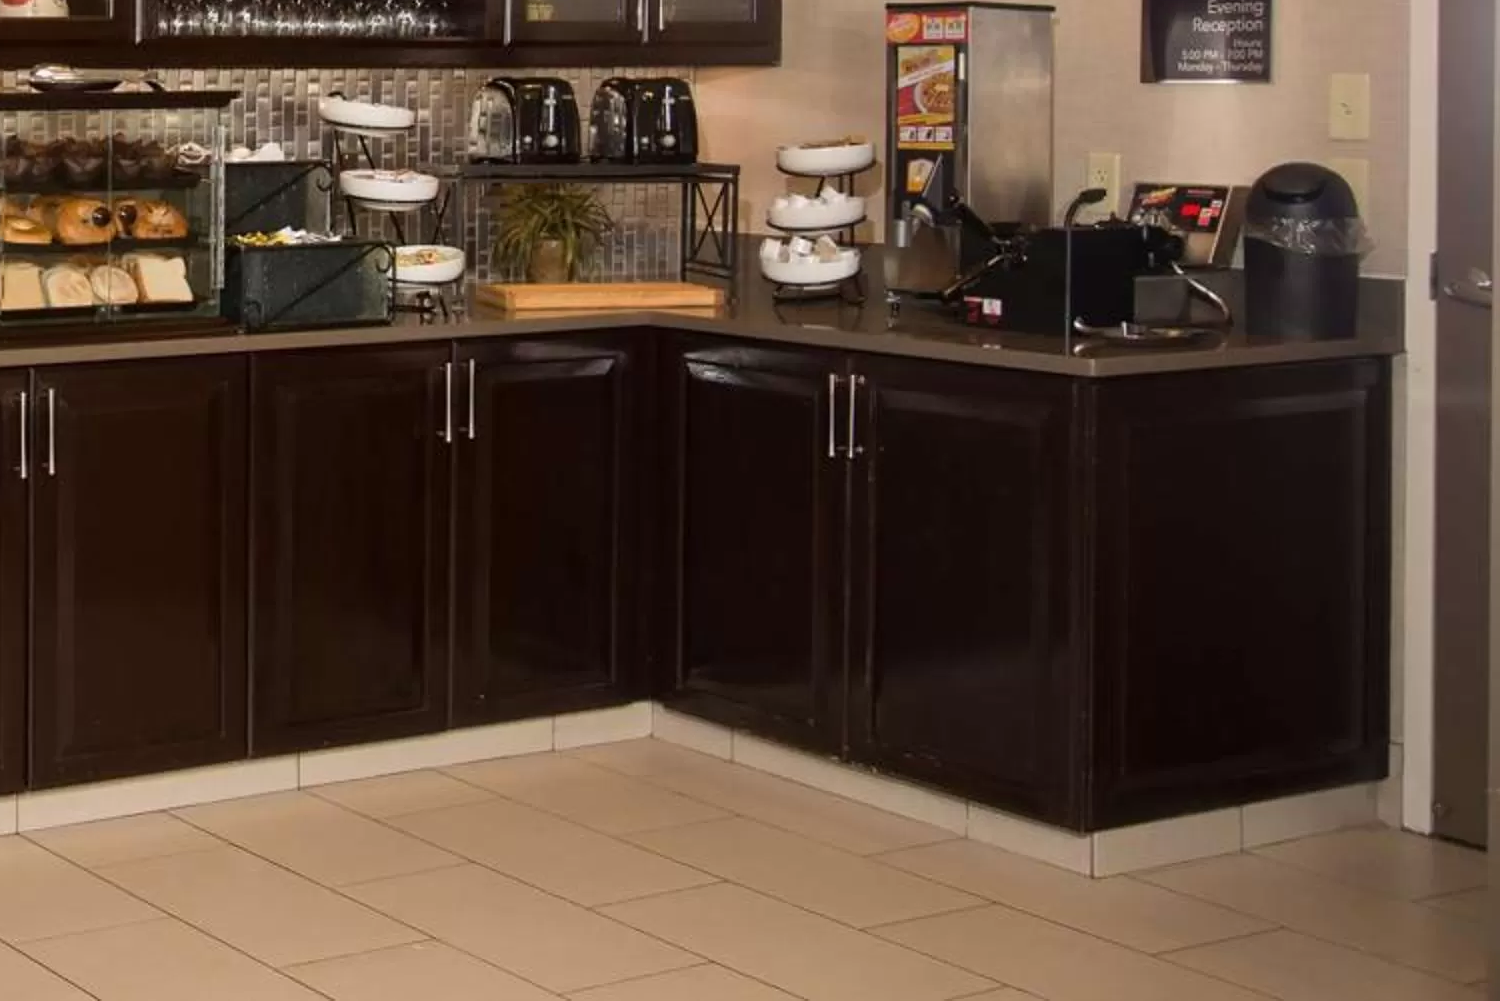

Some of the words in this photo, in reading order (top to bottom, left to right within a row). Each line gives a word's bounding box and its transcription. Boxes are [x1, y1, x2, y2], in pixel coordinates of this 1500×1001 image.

[1193, 16, 1263, 35] Reception
[1177, 62, 1213, 75] Monday
[1220, 61, 1264, 75] Thursday
